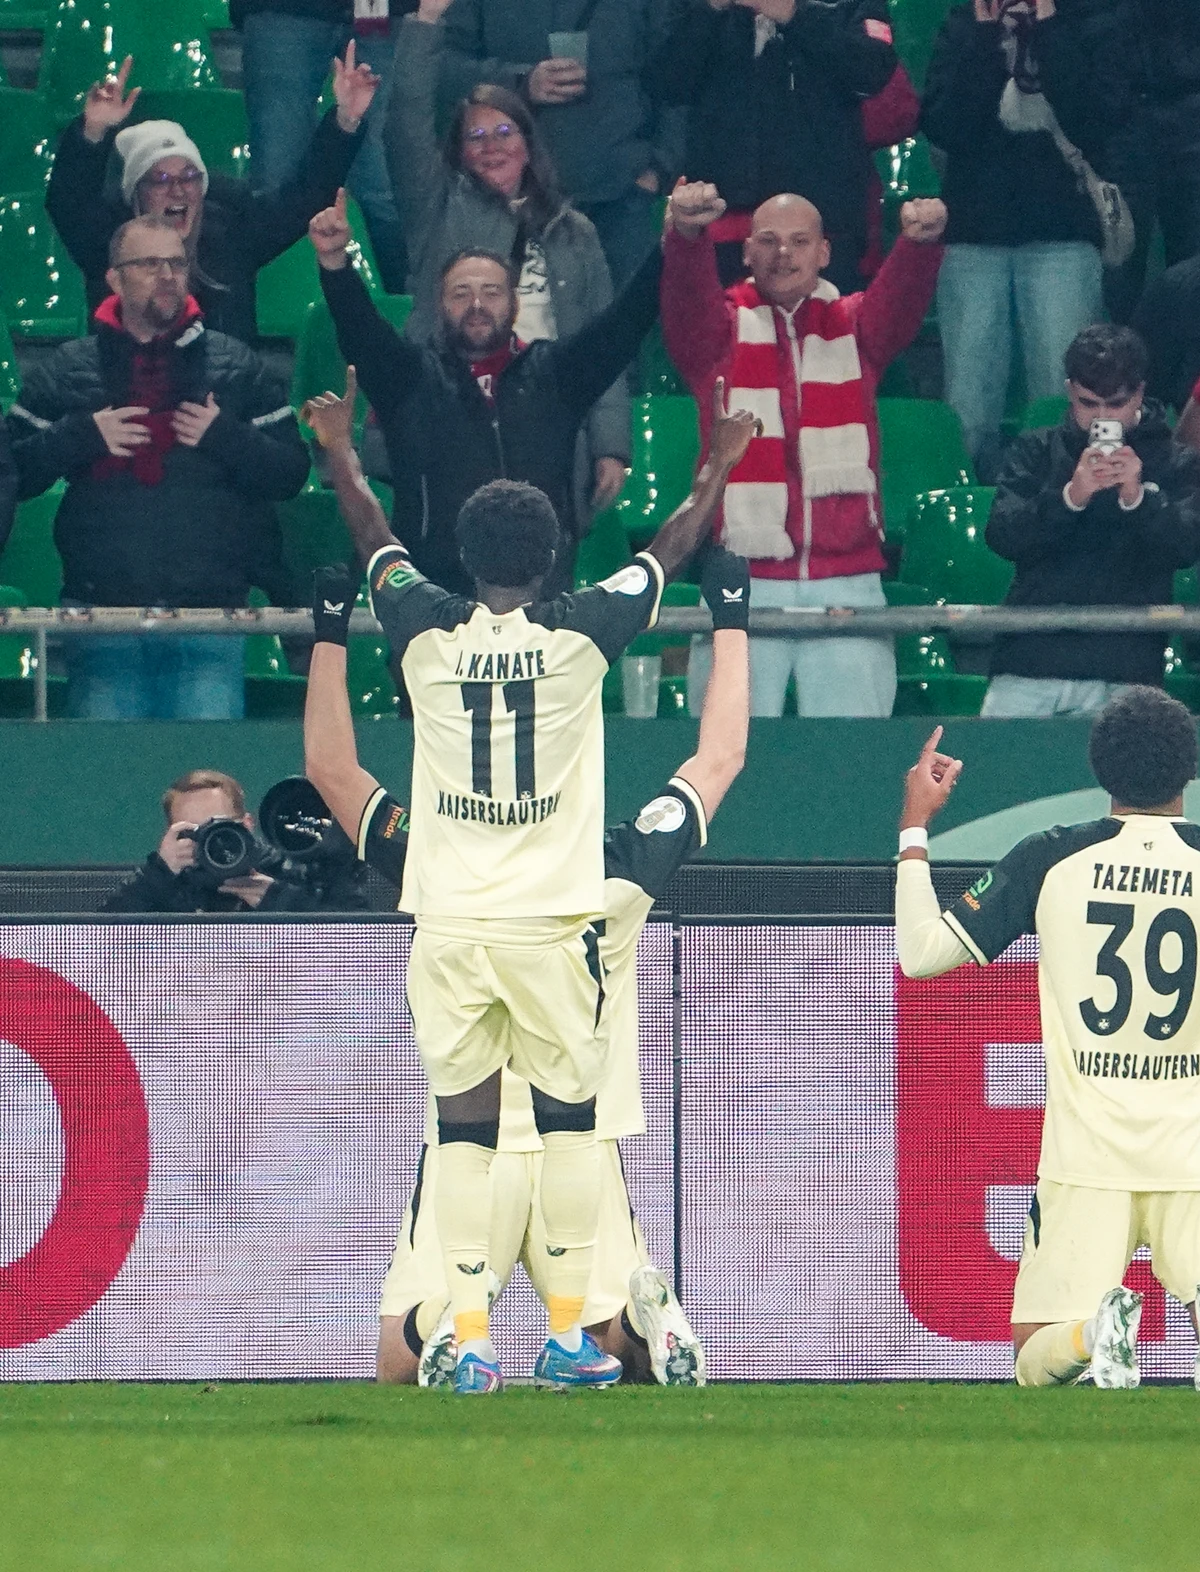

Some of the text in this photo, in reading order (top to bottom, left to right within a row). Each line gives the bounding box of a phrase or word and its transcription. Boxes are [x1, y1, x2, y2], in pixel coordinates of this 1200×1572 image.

[468, 649, 546, 680] KANATE
[460, 679, 536, 801] 11
[1093, 863, 1193, 897] TAZEMETA
[1078, 900, 1199, 1041] 39
